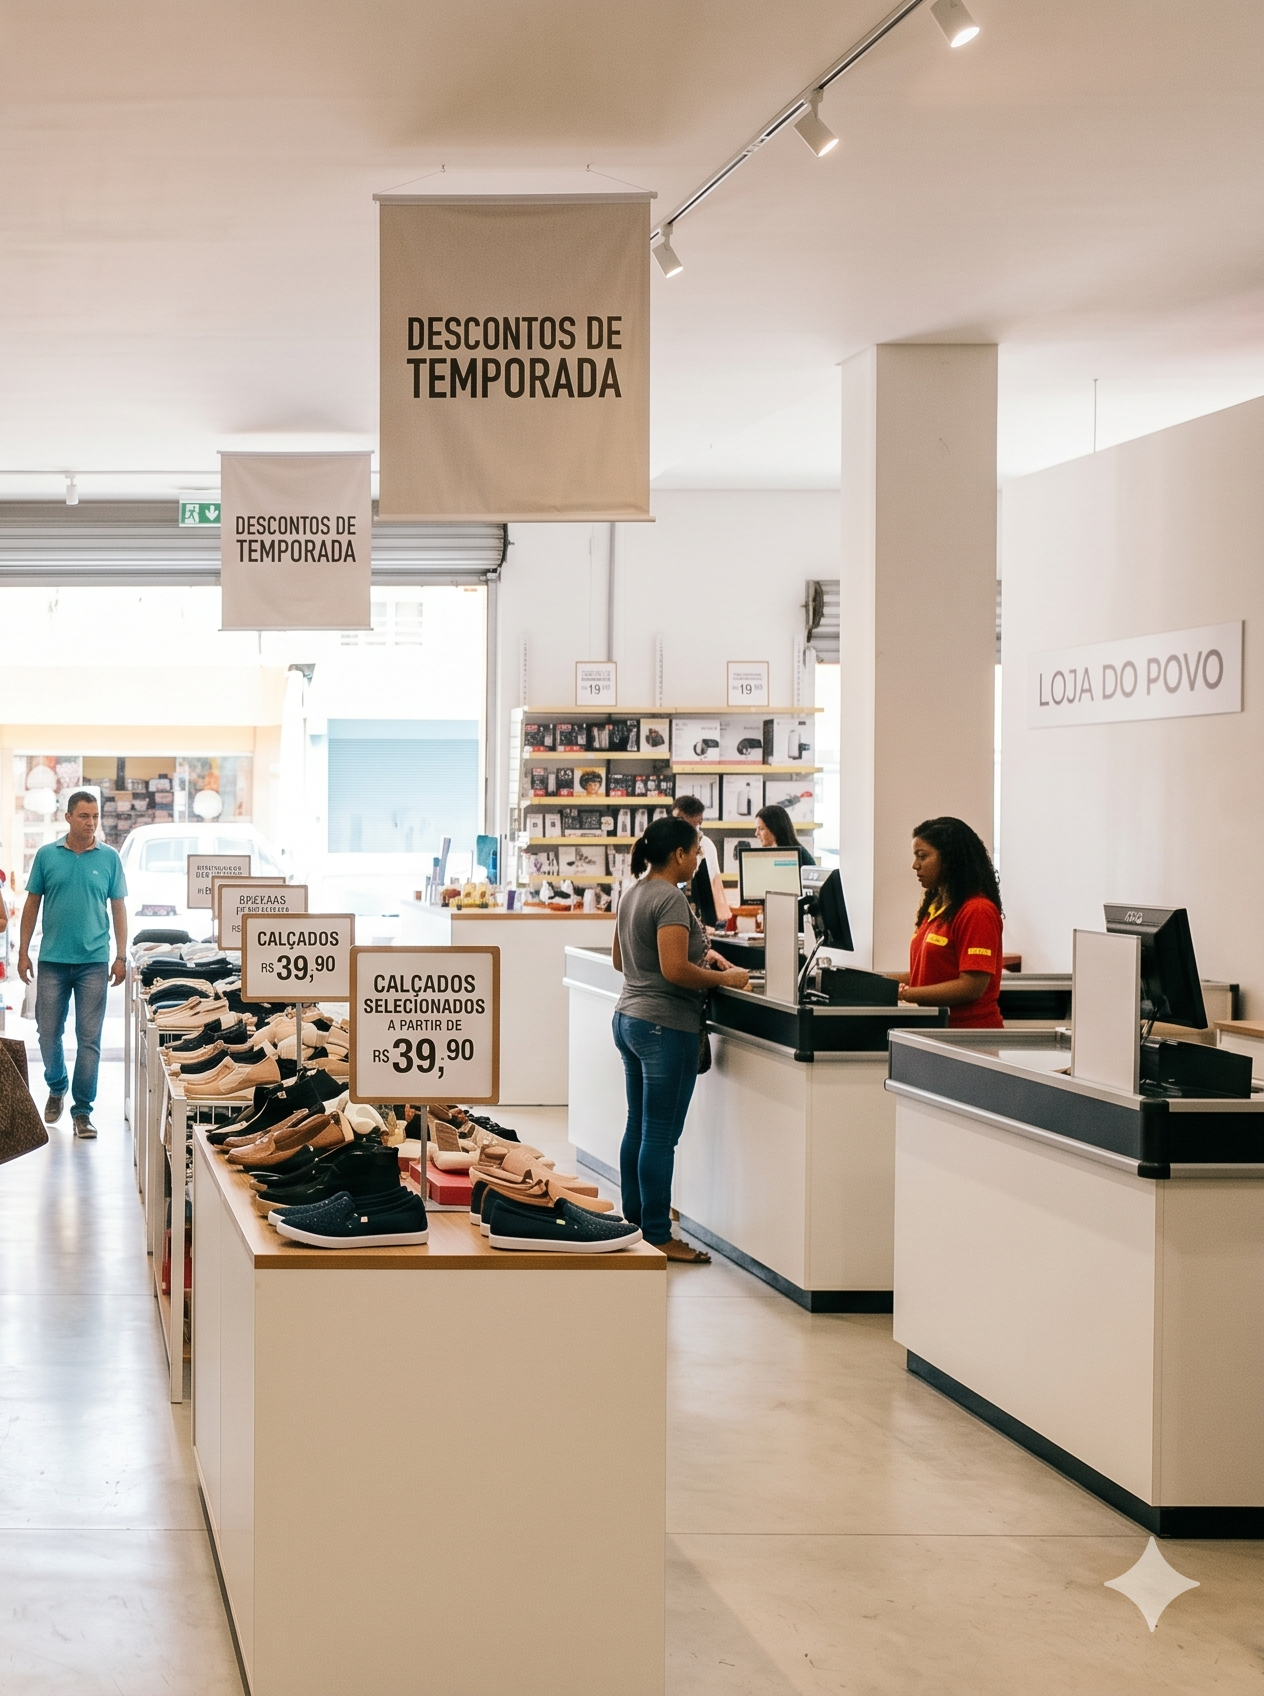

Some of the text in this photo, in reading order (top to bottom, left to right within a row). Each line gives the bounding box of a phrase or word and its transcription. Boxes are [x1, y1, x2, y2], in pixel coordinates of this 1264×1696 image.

[408, 316, 622, 350] DESCONTOS DE
[406, 357, 622, 398] TEMPORADA
[236, 516, 356, 535] DESCONTOS DE
[236, 539, 356, 562] TEMPORADA
[1039, 648, 1224, 707] LOJA DO POVO
[257, 931, 339, 950] CALÇADOS
[373, 974, 476, 997] CALÇADOS
[363, 998, 486, 1014] SELECIONADOS
[387, 1019, 462, 1031] A PARTIR DE
[372, 1048, 390, 1063] R$
